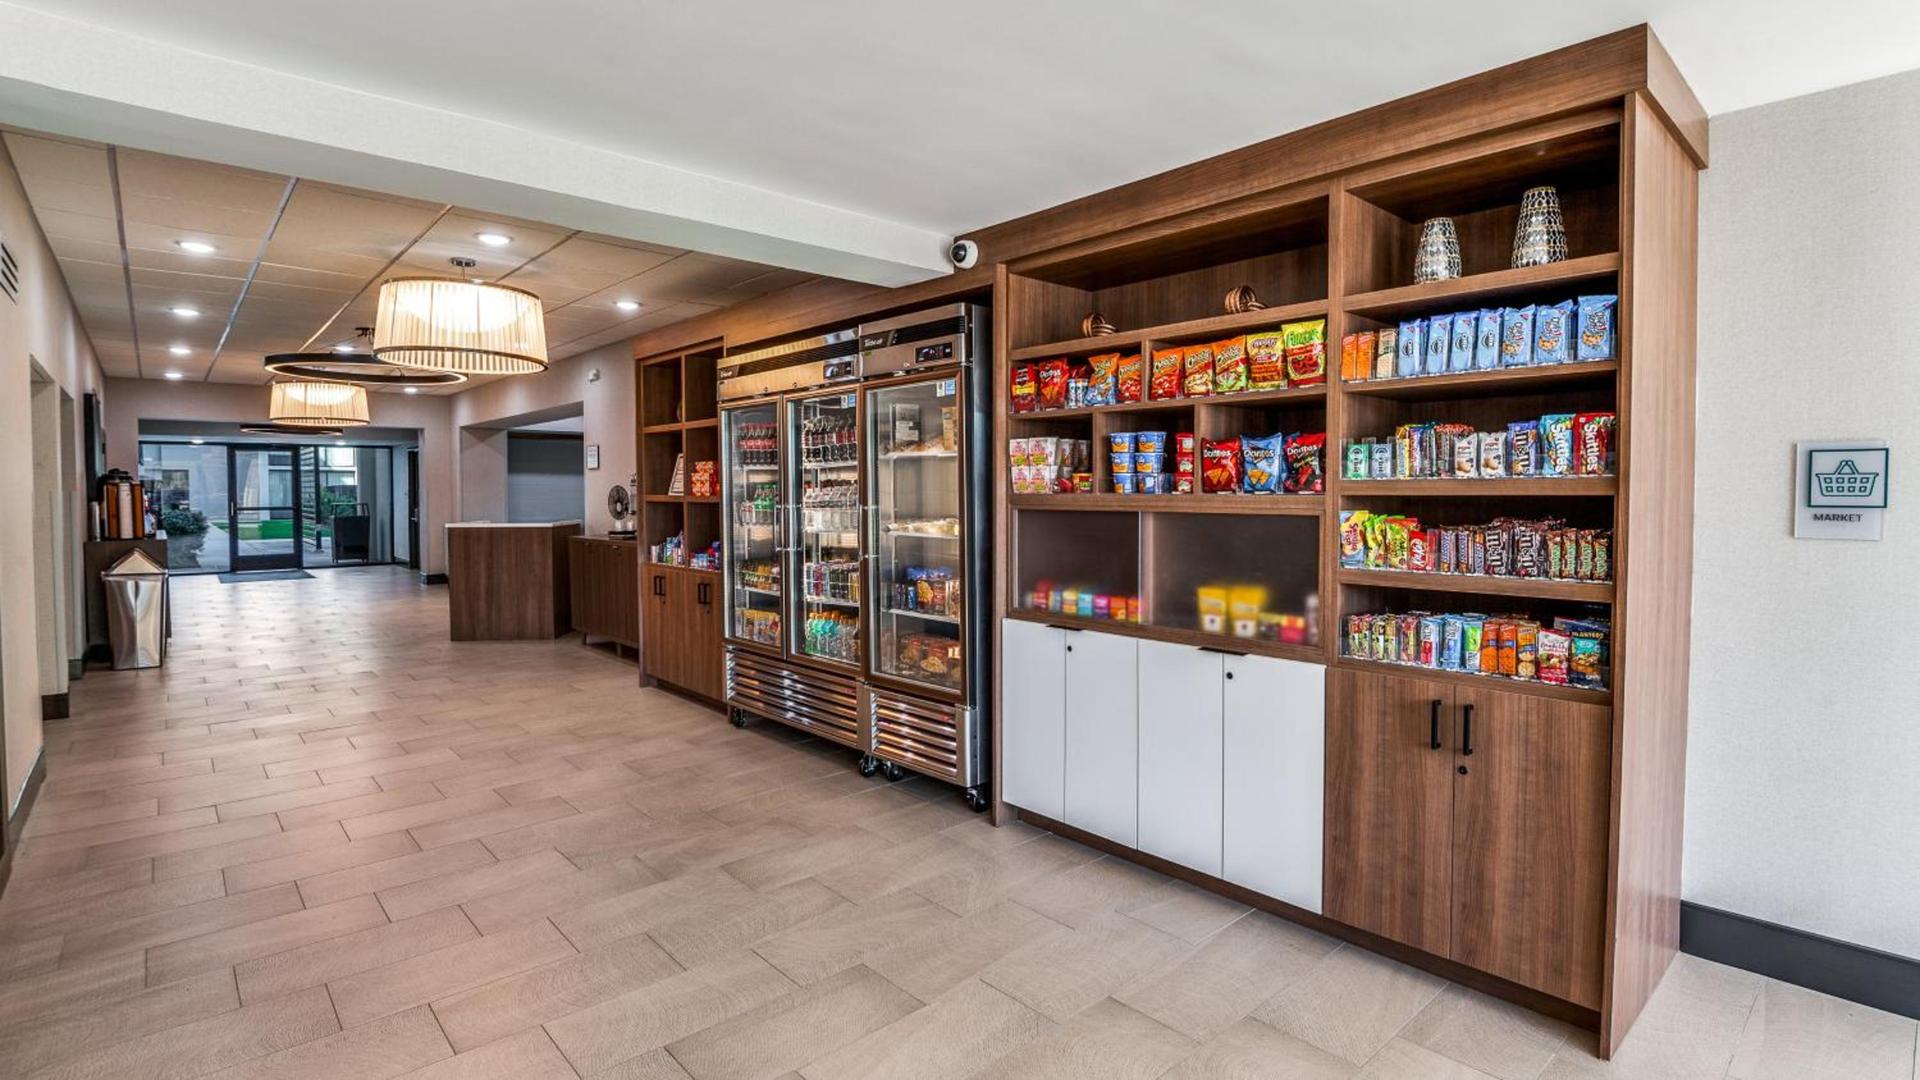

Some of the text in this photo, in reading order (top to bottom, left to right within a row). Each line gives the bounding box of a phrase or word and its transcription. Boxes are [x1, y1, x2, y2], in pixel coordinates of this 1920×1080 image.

[1203, 448, 1233, 458] Doritos
[1287, 444, 1318, 456] Doritos
[1551, 423, 1571, 473] Skittles
[1584, 423, 1600, 472] Skittles
[1243, 449, 1275, 459] Doritos
[1812, 513, 1863, 522] MARKET
